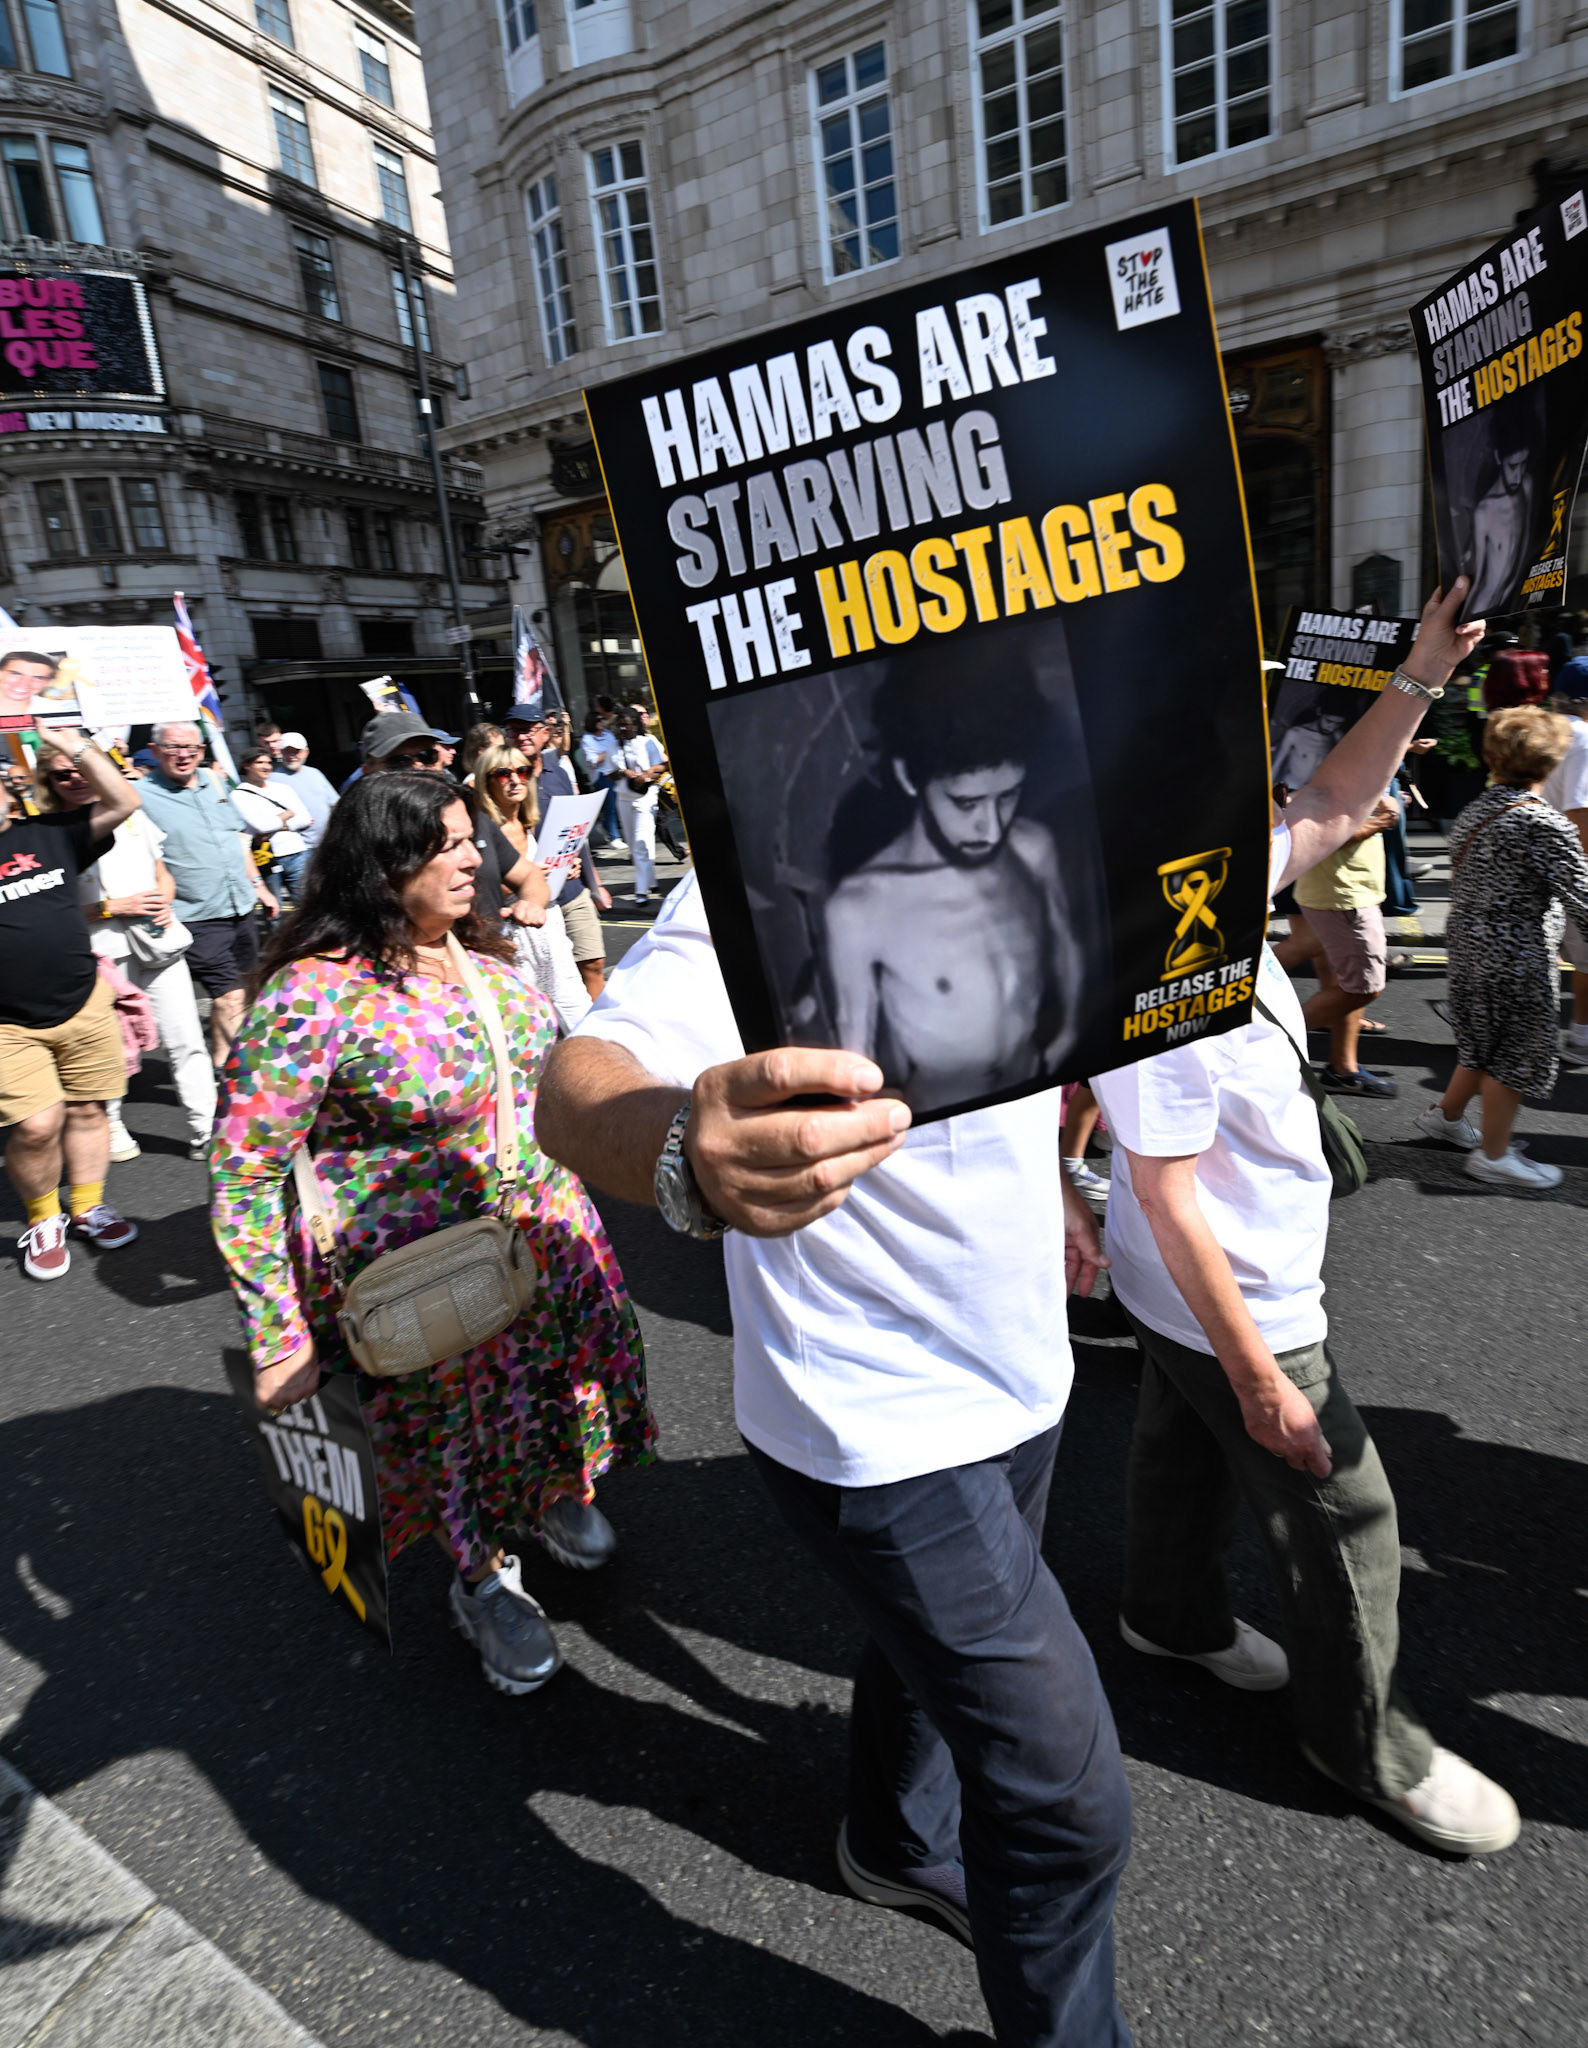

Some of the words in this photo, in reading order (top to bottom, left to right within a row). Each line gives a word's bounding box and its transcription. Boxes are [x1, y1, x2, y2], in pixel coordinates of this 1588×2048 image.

[0, 278, 86, 309] BUR
[1125, 268, 1159, 292] THE
[1423, 262, 1499, 345] HAMAS
[1499, 226, 1548, 295] ARE
[1124, 286, 1164, 314] HATE
[0, 310, 85, 338] LES
[1432, 291, 1533, 385] STARVING
[4, 339, 99, 377] QUE
[1437, 376, 1474, 427] THE
[1473, 310, 1583, 409] HOSTAGES
[640, 325, 902, 488] HAMAS
[915, 277, 1057, 408] ARE
[666, 409, 1012, 588] STARVING
[685, 581, 812, 690] THE
[813, 482, 1185, 659] HOSTAGES
[1296, 612, 1365, 640] HAMAS
[1362, 619, 1402, 644] ARE
[1290, 635, 1378, 665] STARVING
[1285, 657, 1318, 682] THE
[0, 853, 43, 879] ck
[1134, 970, 1215, 1013] RELEASE
[1218, 957, 1253, 985] THE
[1123, 975, 1254, 1041] HOSTAGES
[1166, 1015, 1212, 1043] NOW
[258, 1420, 366, 1522] THEM
